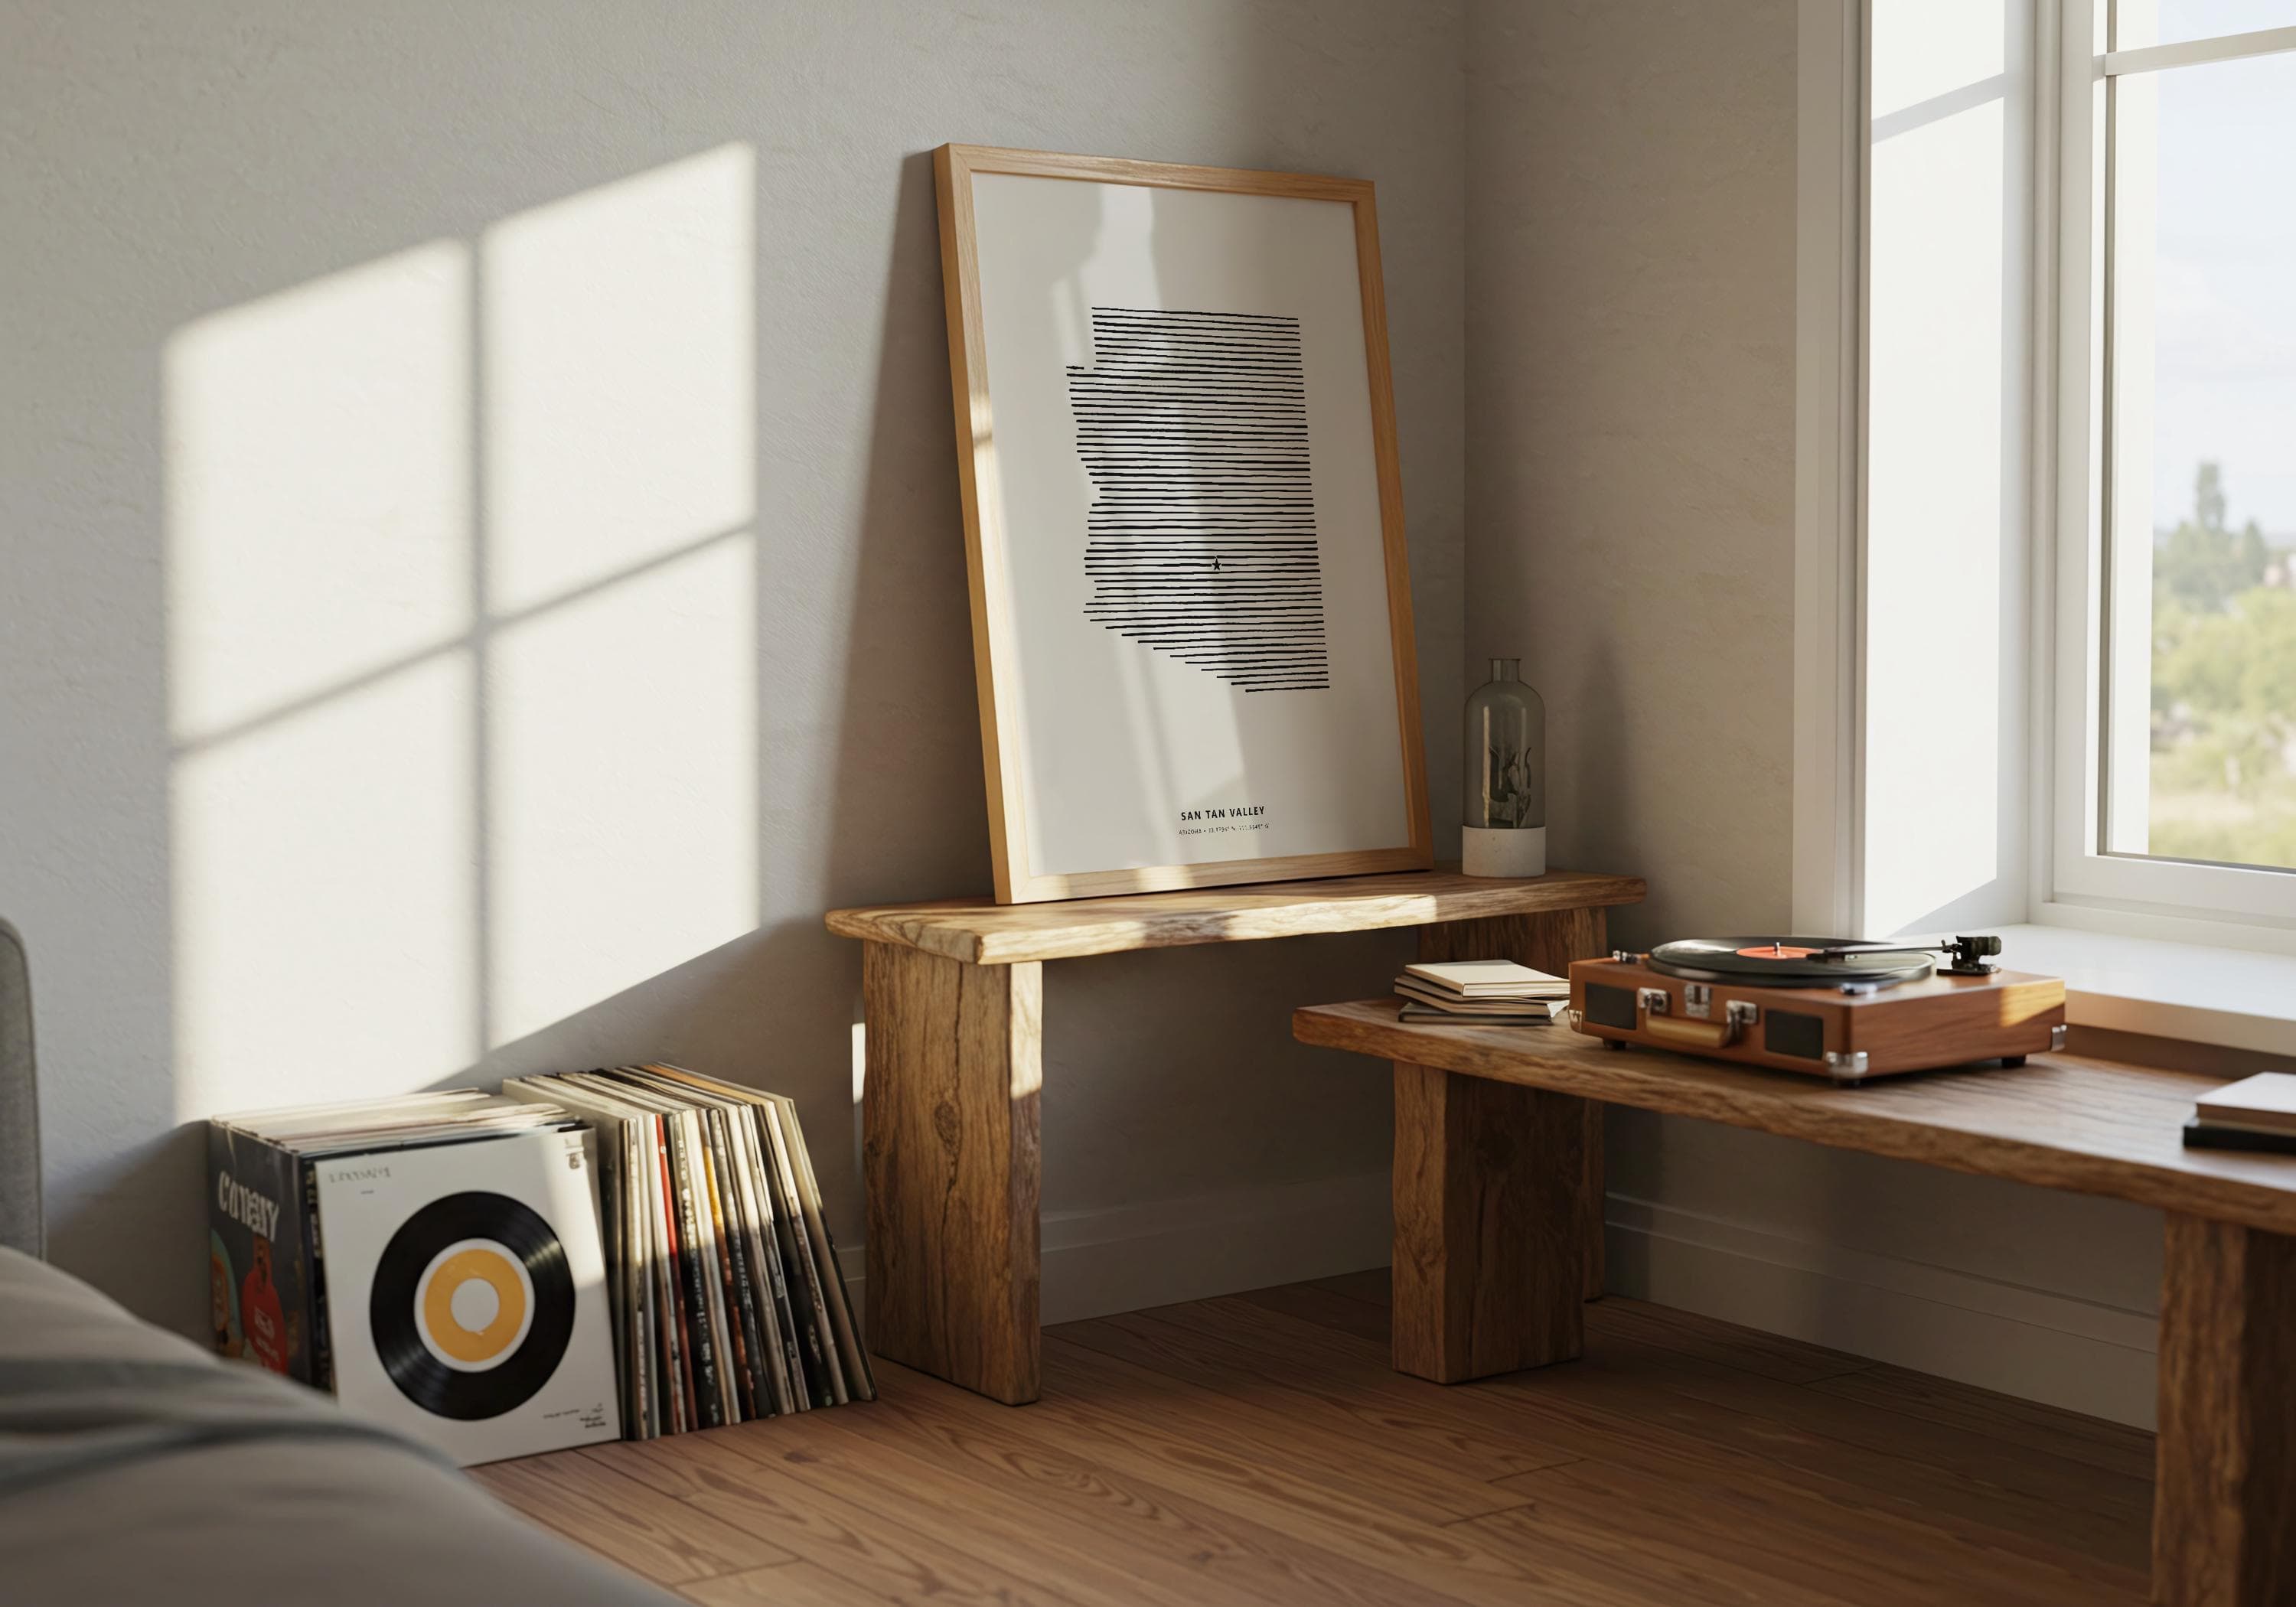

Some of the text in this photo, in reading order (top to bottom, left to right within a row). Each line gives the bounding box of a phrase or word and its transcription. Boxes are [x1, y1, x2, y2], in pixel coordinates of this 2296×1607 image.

[1181, 806, 1264, 820] SAN TAN VALLEY
